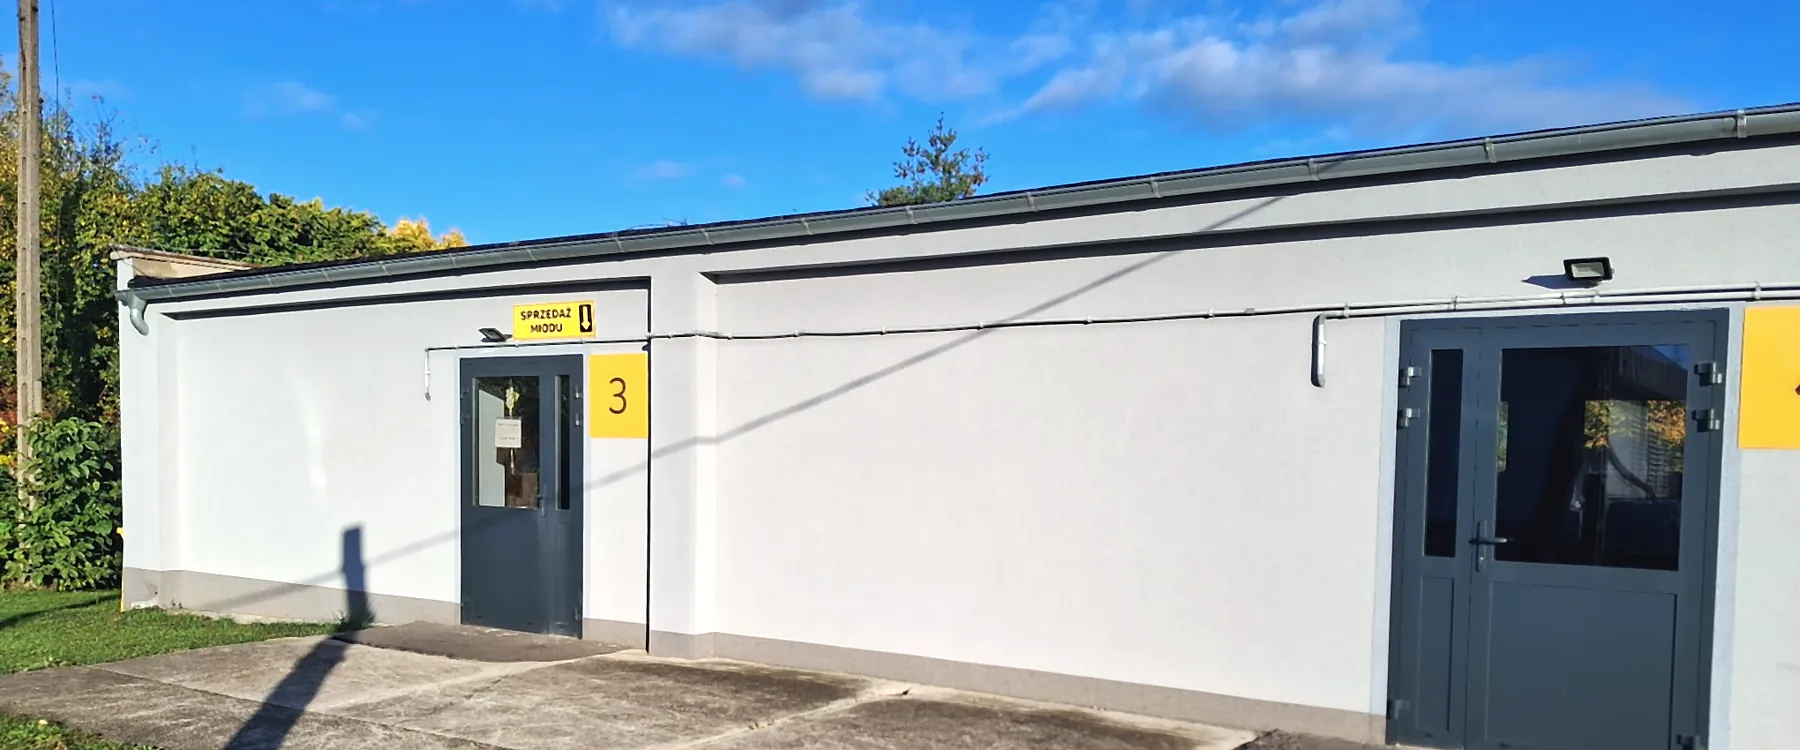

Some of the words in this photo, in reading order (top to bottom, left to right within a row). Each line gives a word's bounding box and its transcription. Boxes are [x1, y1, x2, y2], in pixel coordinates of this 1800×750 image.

[520, 307, 572, 321] SPRZEDAŻ
[530, 323, 563, 333] MIODU
[609, 377, 627, 414] 3
